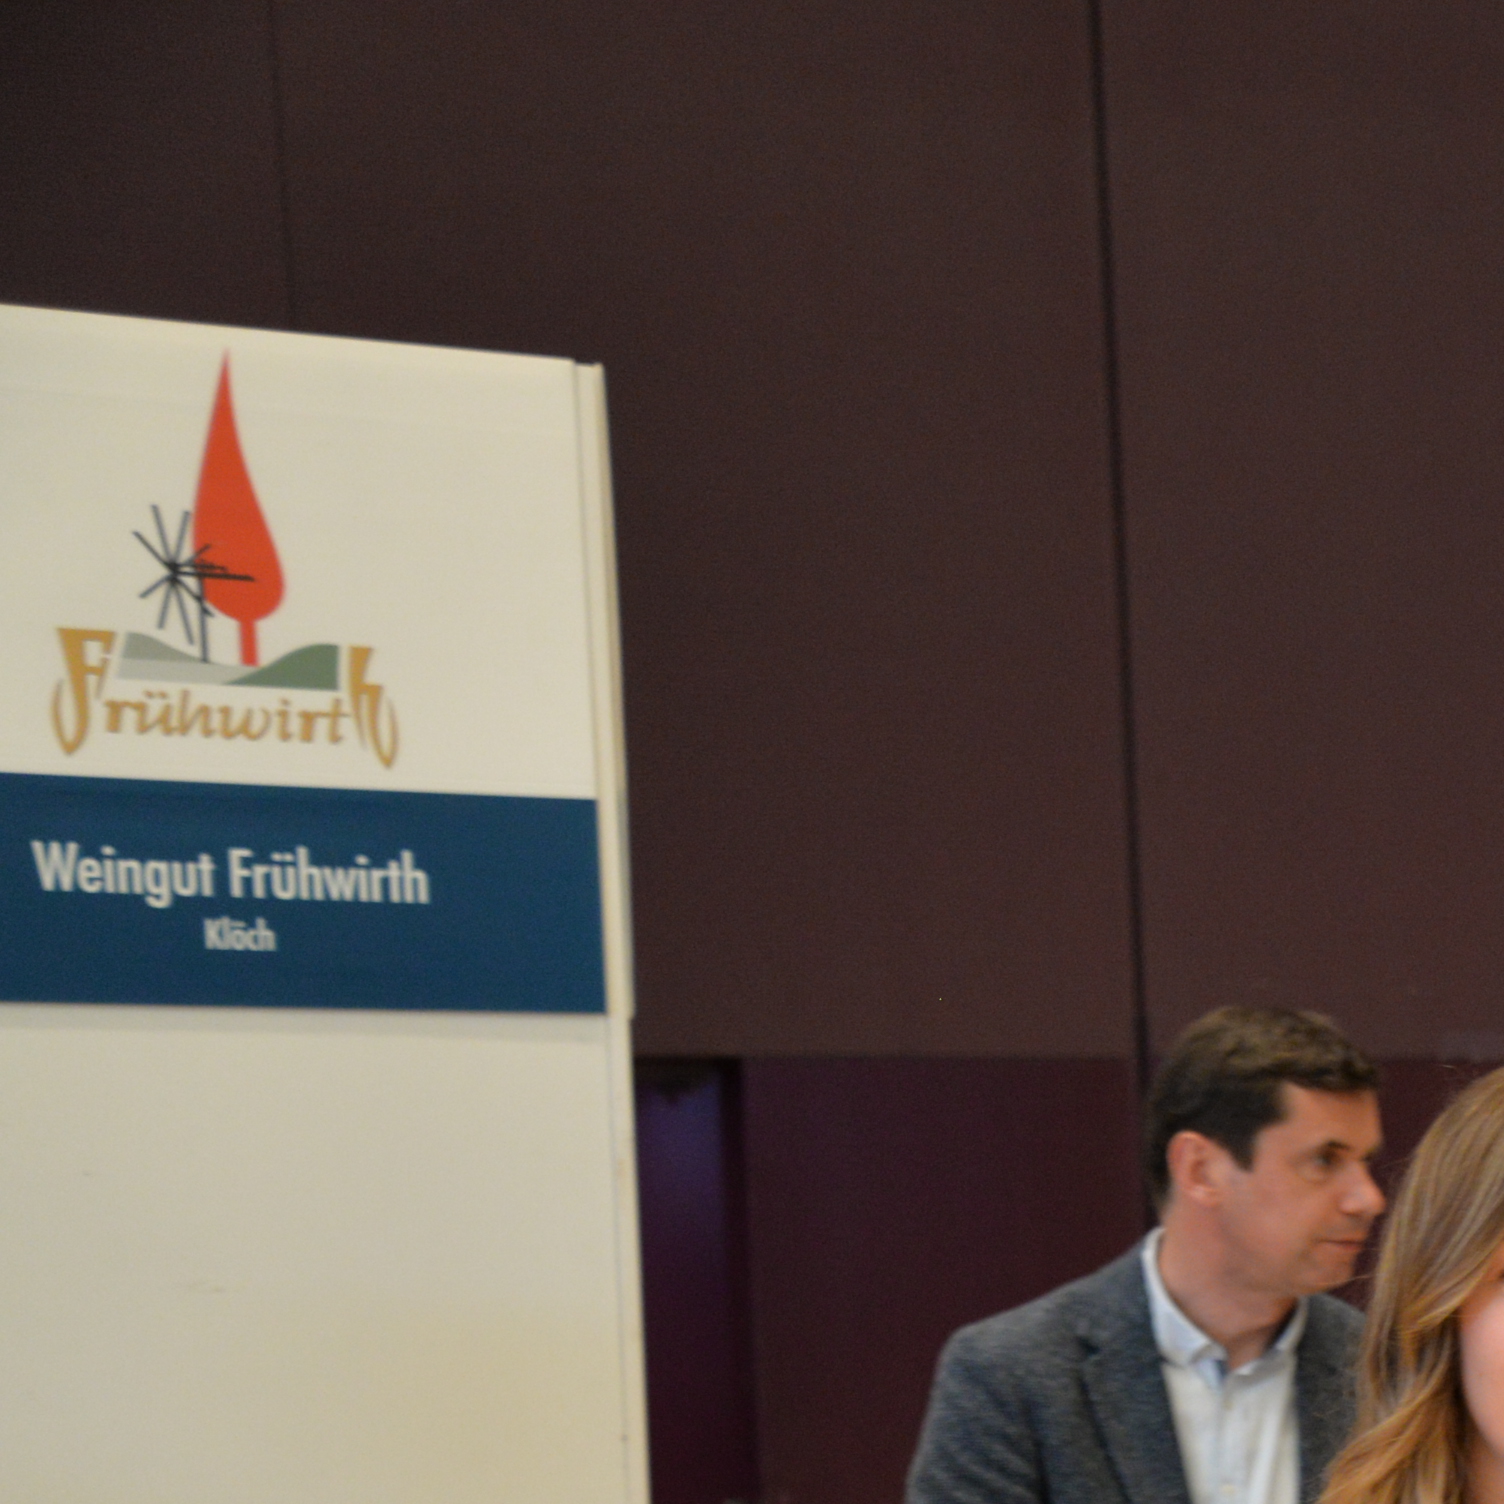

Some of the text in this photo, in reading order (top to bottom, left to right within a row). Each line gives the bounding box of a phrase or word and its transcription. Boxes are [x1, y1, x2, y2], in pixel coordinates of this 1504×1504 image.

[52, 626, 399, 769] Frühwirth
[31, 840, 430, 908] Weingut Frühwirth
[204, 916, 277, 951] Klöch
